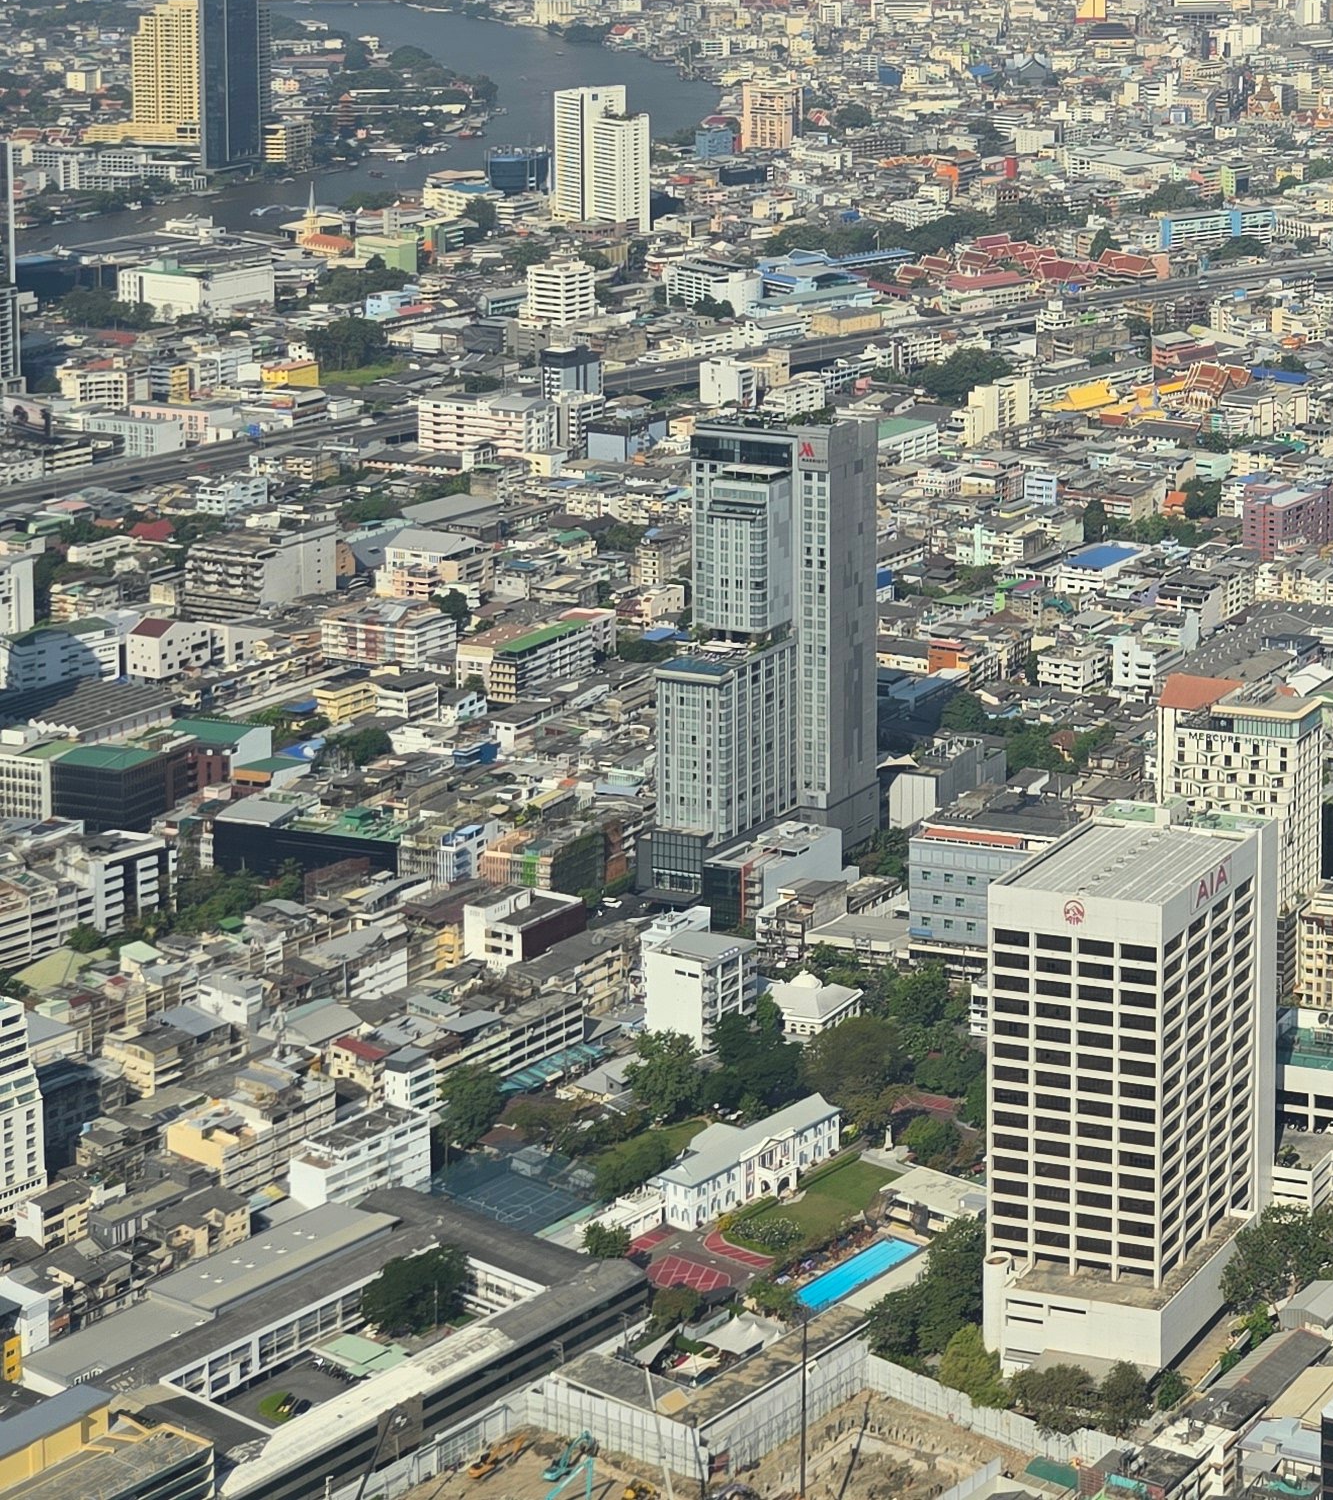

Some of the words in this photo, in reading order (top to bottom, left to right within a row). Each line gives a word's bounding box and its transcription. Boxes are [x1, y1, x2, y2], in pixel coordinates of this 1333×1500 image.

[1189, 731, 1240, 744] MERCURE
[1244, 737, 1279, 748] HOTEL
[1196, 864, 1228, 908] AIA
